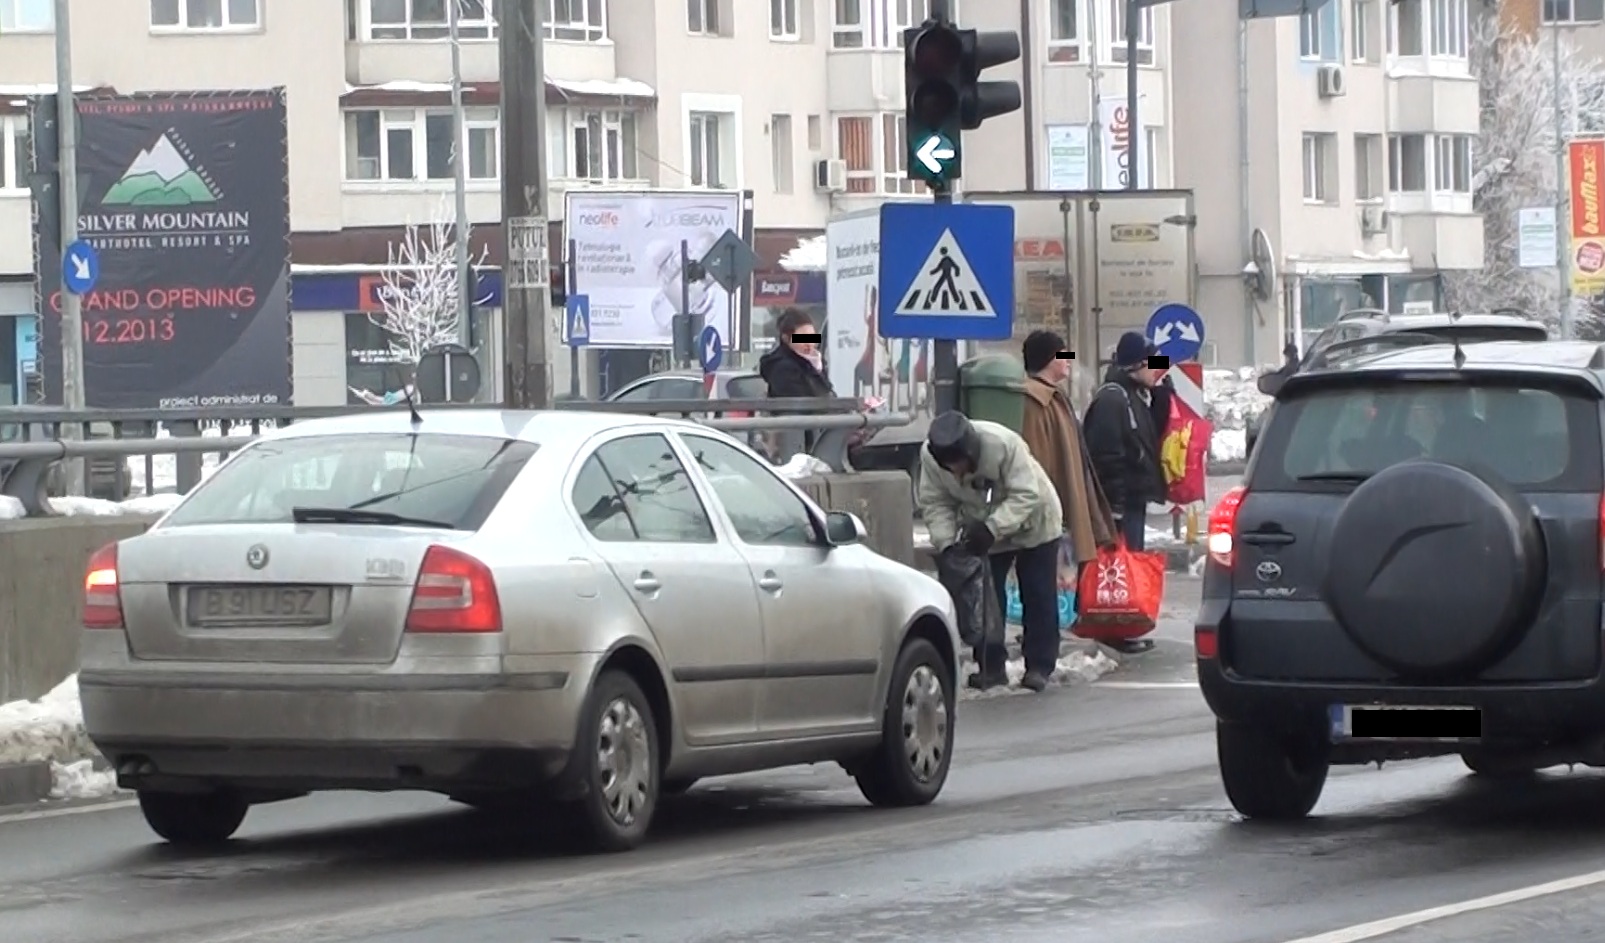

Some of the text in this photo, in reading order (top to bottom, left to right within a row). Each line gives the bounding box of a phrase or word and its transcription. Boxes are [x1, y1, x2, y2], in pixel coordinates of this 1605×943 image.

[77, 211, 249, 231] SILVER MOUNTAIN
[579, 211, 619, 226] neolife
[162, 236, 206, 247] RESORT
[229, 234, 250, 246] SPA
[147, 287, 256, 309] OPENING
[262, 393, 278, 404] de
[206, 591, 221, 616] B
[231, 591, 253, 616] 91
